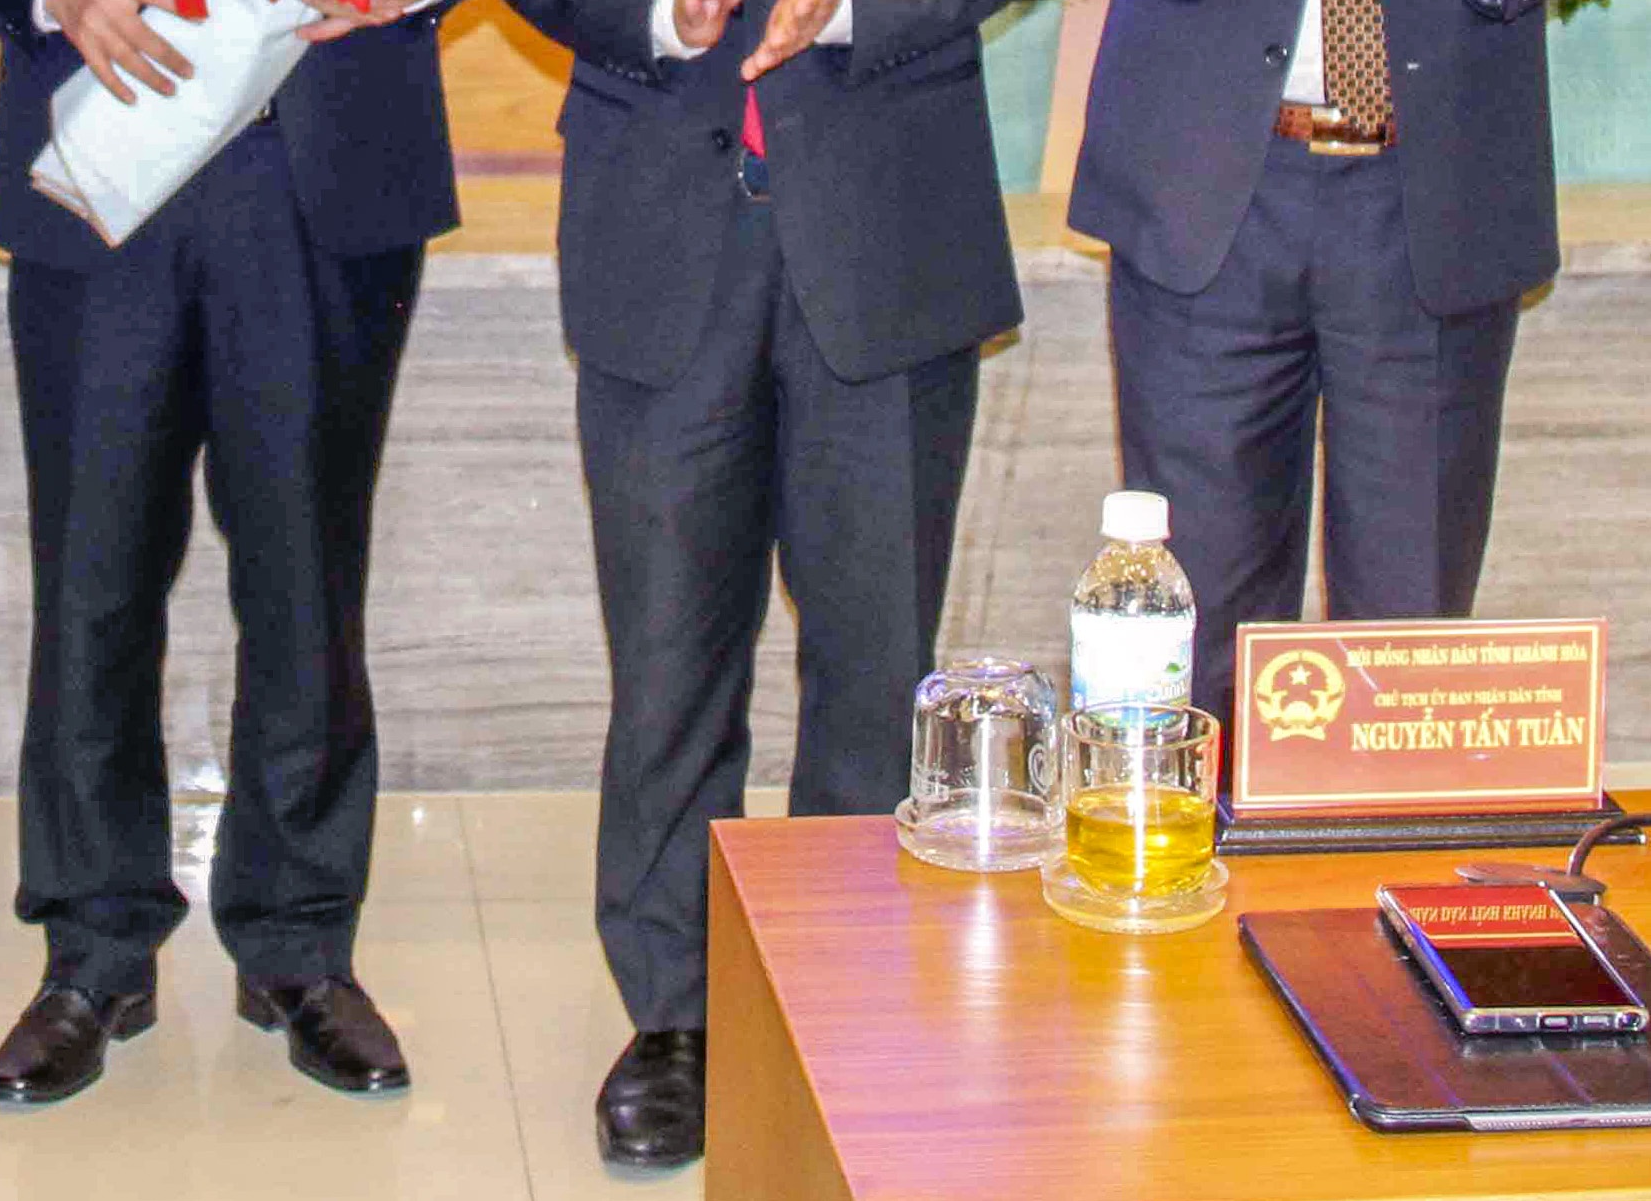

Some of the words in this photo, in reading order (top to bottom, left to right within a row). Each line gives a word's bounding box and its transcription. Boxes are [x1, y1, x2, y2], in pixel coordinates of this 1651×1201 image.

[1350, 707, 1456, 753] NGUYỄN
[1460, 706, 1512, 748] TẤN
[1515, 709, 1587, 747] TUÂN
